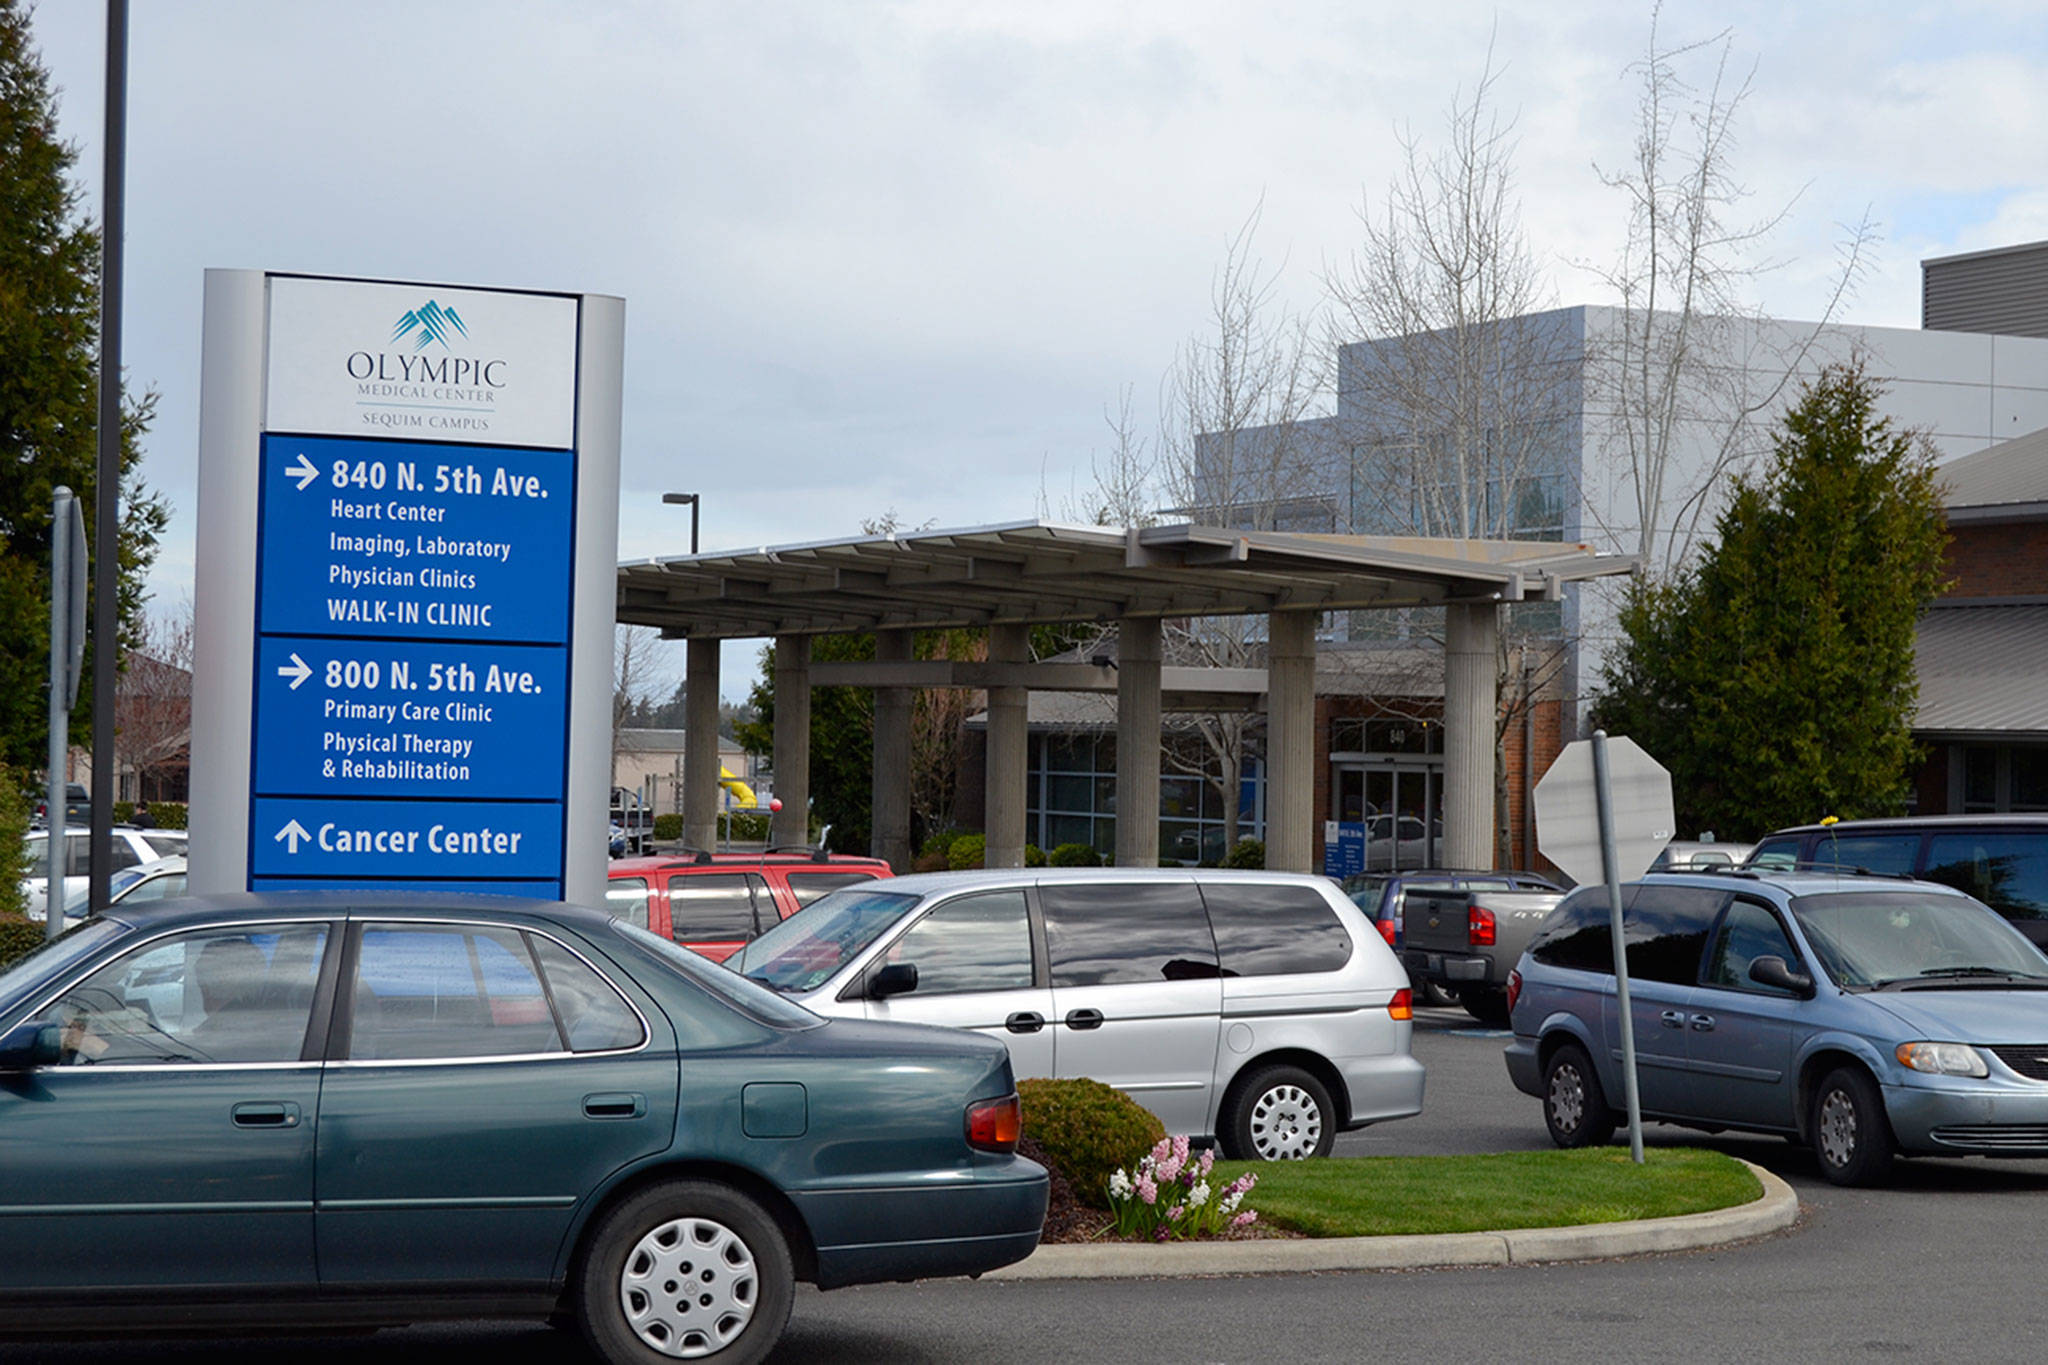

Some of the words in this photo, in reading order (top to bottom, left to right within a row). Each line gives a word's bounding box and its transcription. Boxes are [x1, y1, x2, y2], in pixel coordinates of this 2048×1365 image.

[347, 352, 507, 388] OLYMPIC
[357, 384, 429, 399] MEDICAL
[433, 388, 495, 402] CENTER
[362, 413, 422, 428] SEQUIM
[429, 416, 489, 430] CAMPUS
[332, 460, 387, 490] 840
[397, 462, 424, 492] N.
[434, 465, 482, 495] 5th
[491, 467, 548, 499] Ave.
[331, 498, 382, 520] Heart
[387, 501, 446, 522] Center
[330, 531, 411, 558] Imaging,
[417, 535, 511, 563] Laboratory
[329, 564, 414, 589] Physician
[420, 568, 476, 589] Clinics
[327, 598, 419, 624] WALK-IN
[426, 602, 492, 627] CLINIC
[325, 660, 380, 689] 800
[391, 661, 418, 691] N.
[428, 662, 476, 692] 5th
[484, 664, 542, 694] Ave.
[324, 698, 397, 724] Primary
[402, 701, 440, 721] Care
[445, 702, 492, 722] Clinic
[324, 731, 397, 756] Physical
[402, 733, 473, 759] Therapy
[1390, 729, 1405, 743] 840
[322, 758, 336, 778] &
[342, 759, 470, 780] Rehabilitation
[318, 823, 419, 853] Cancer
[428, 824, 522, 854] Center
